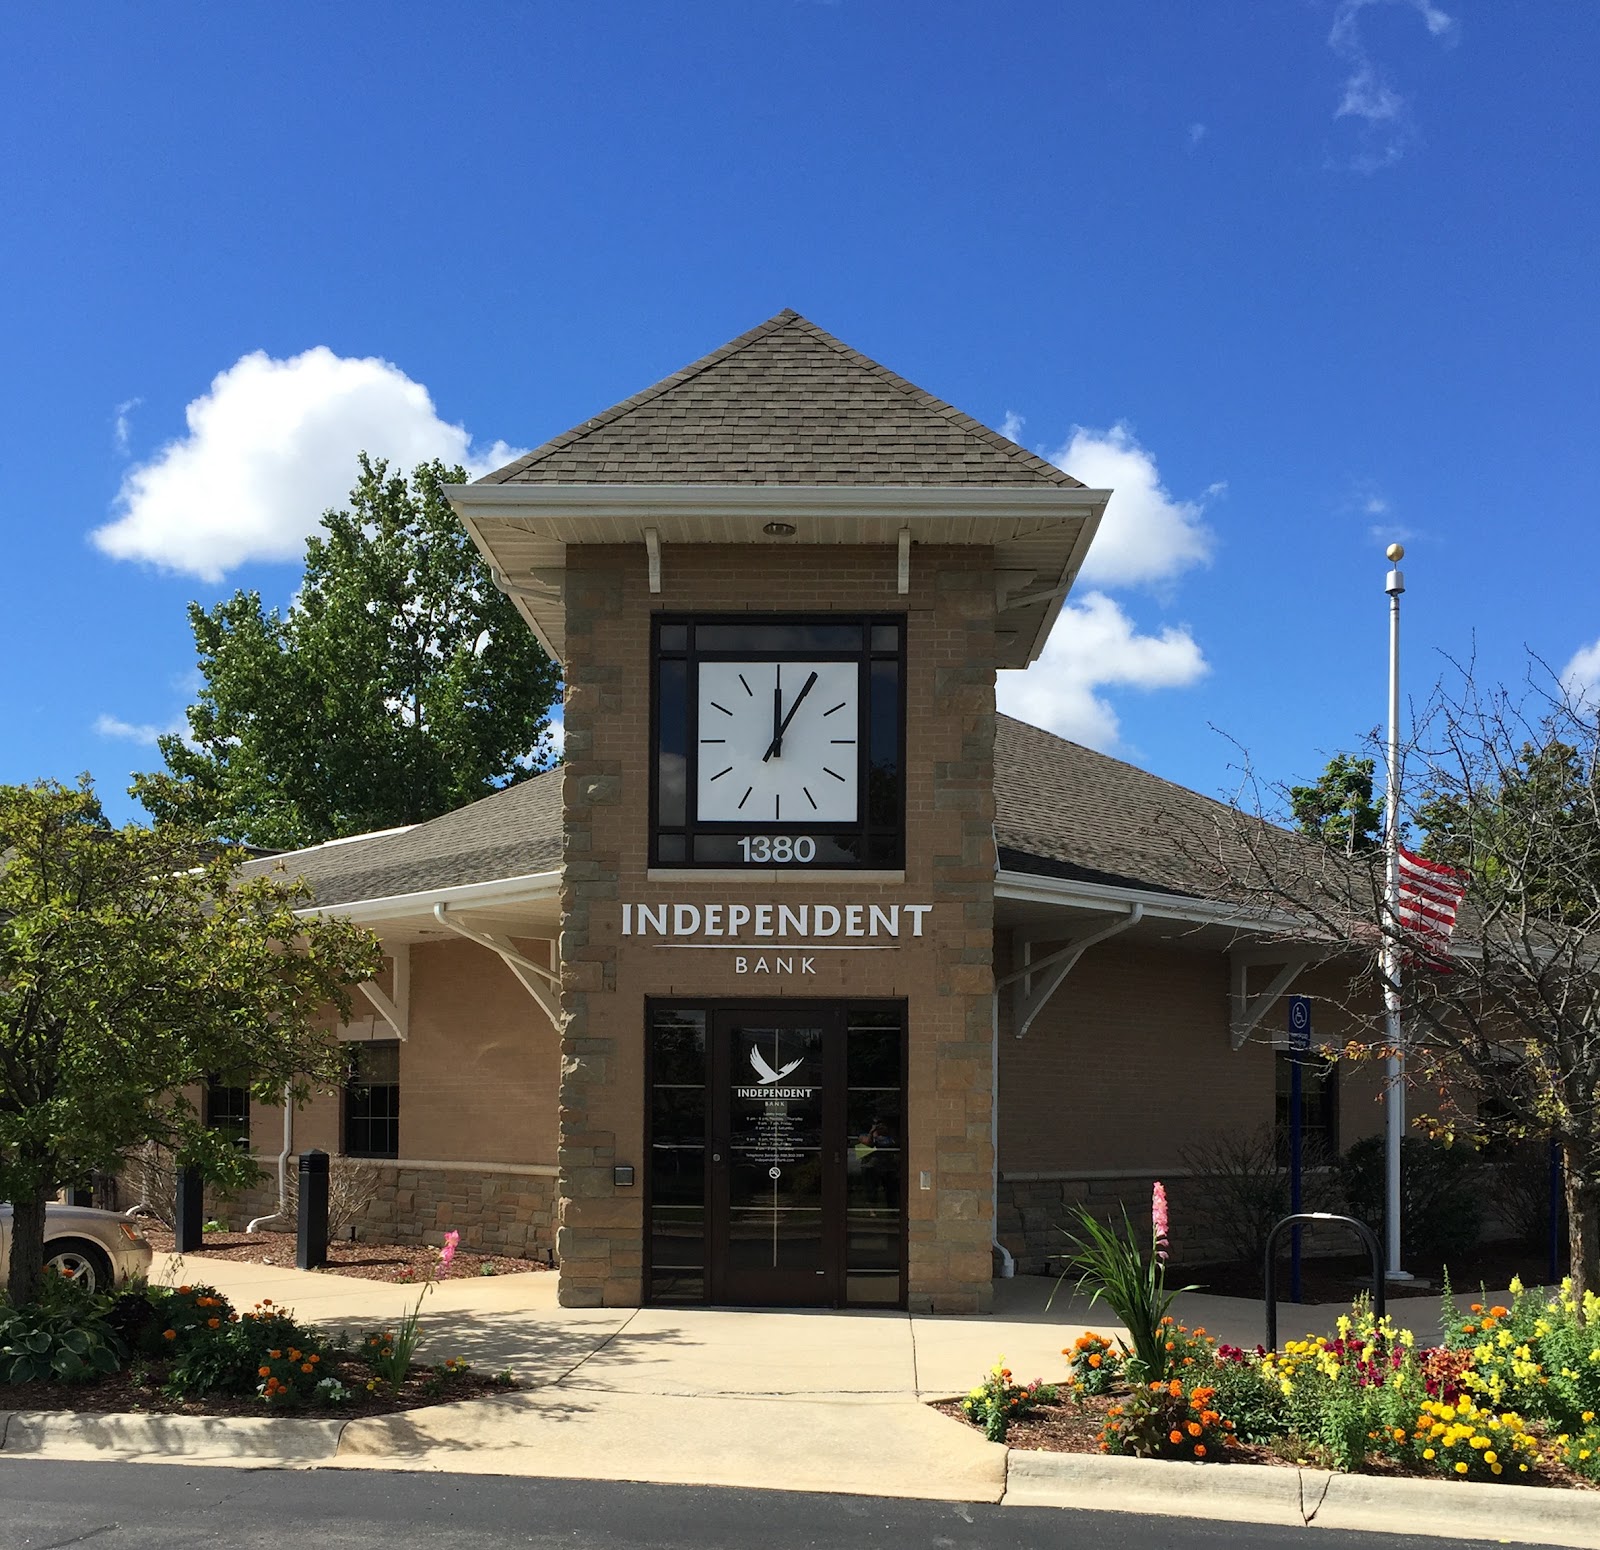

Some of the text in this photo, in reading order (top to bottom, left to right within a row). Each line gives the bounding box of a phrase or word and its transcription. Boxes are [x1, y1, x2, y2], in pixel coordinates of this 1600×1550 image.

[737, 836, 816, 863] 1380
[621, 903, 933, 937] INDEPENDENT
[735, 956, 817, 974] BANK
[737, 1088, 812, 1098] INDEPENDENT
